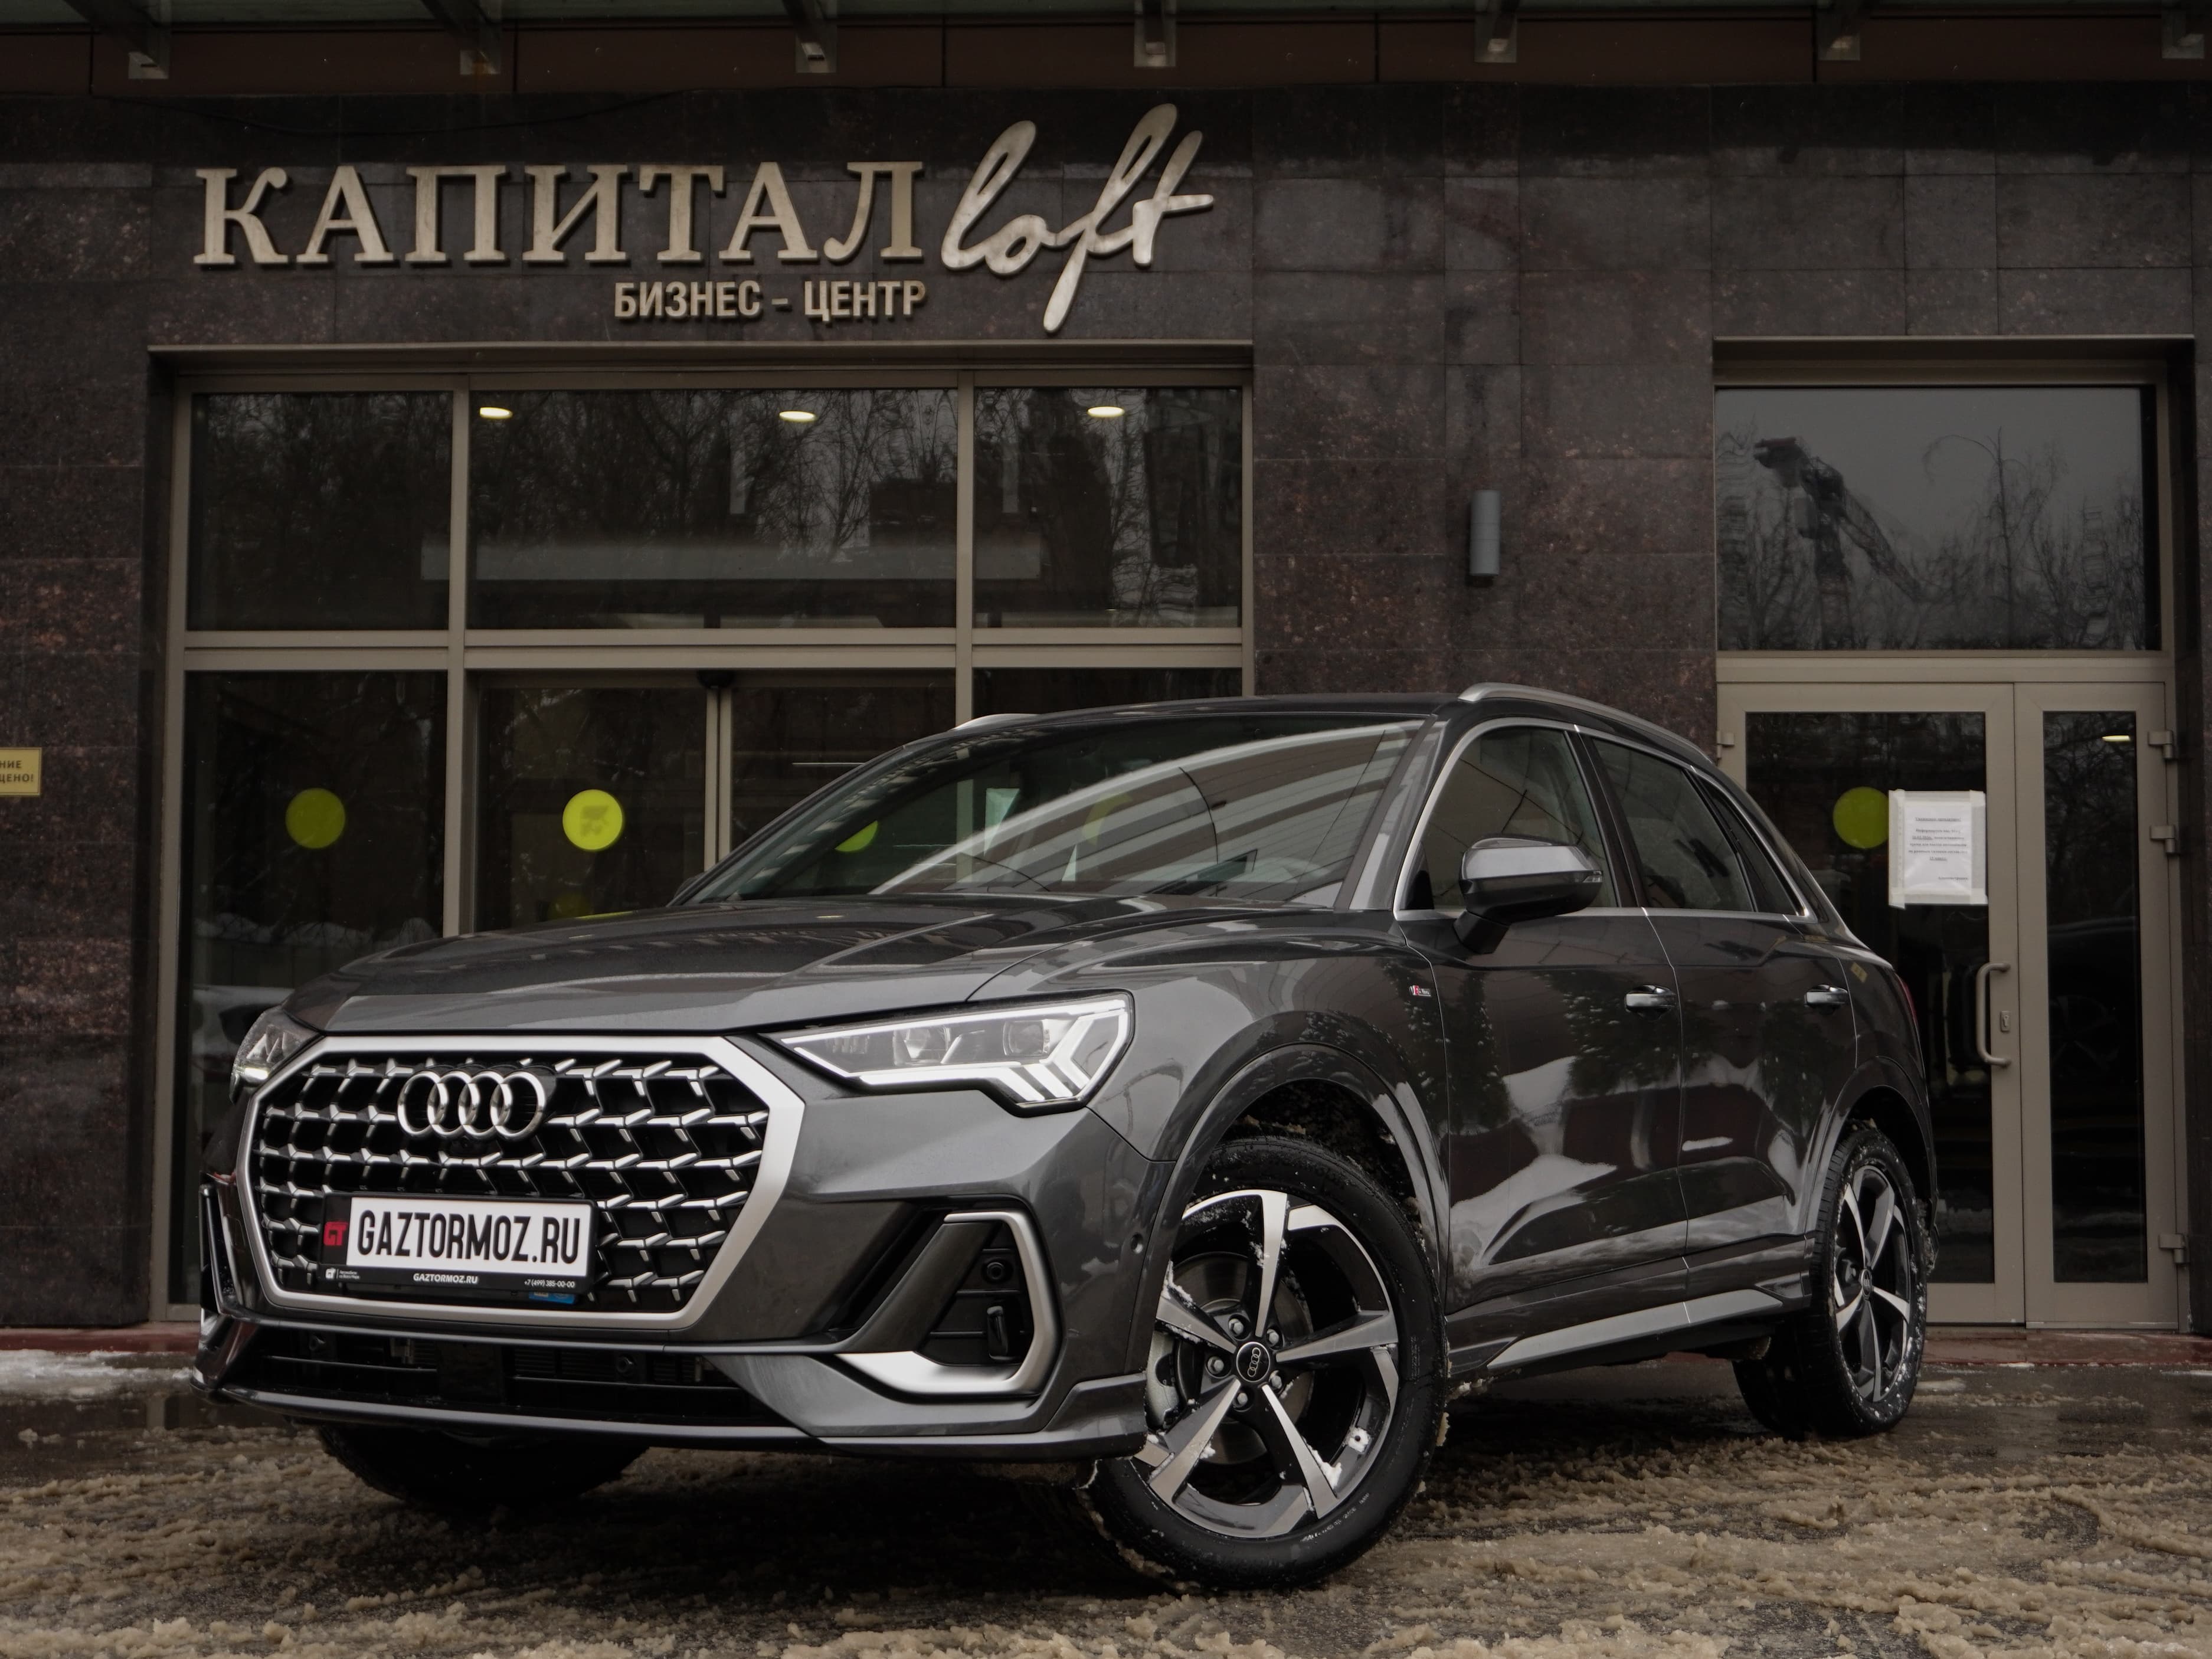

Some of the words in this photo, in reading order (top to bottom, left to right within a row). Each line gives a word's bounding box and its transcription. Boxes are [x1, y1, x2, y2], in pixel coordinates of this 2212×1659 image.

[194, 162, 924, 266] КАПИТАЛ
[941, 103, 1215, 334] loft
[614, 280, 761, 319] БИЗНЕС
[804, 280, 927, 325] ЦЕНТР
[357, 1210, 580, 1264] GAZTORMOZ.RU
[413, 1272, 479, 1284] GAZTORMOZ.RU
[531, 1279, 545, 1287] (499)
